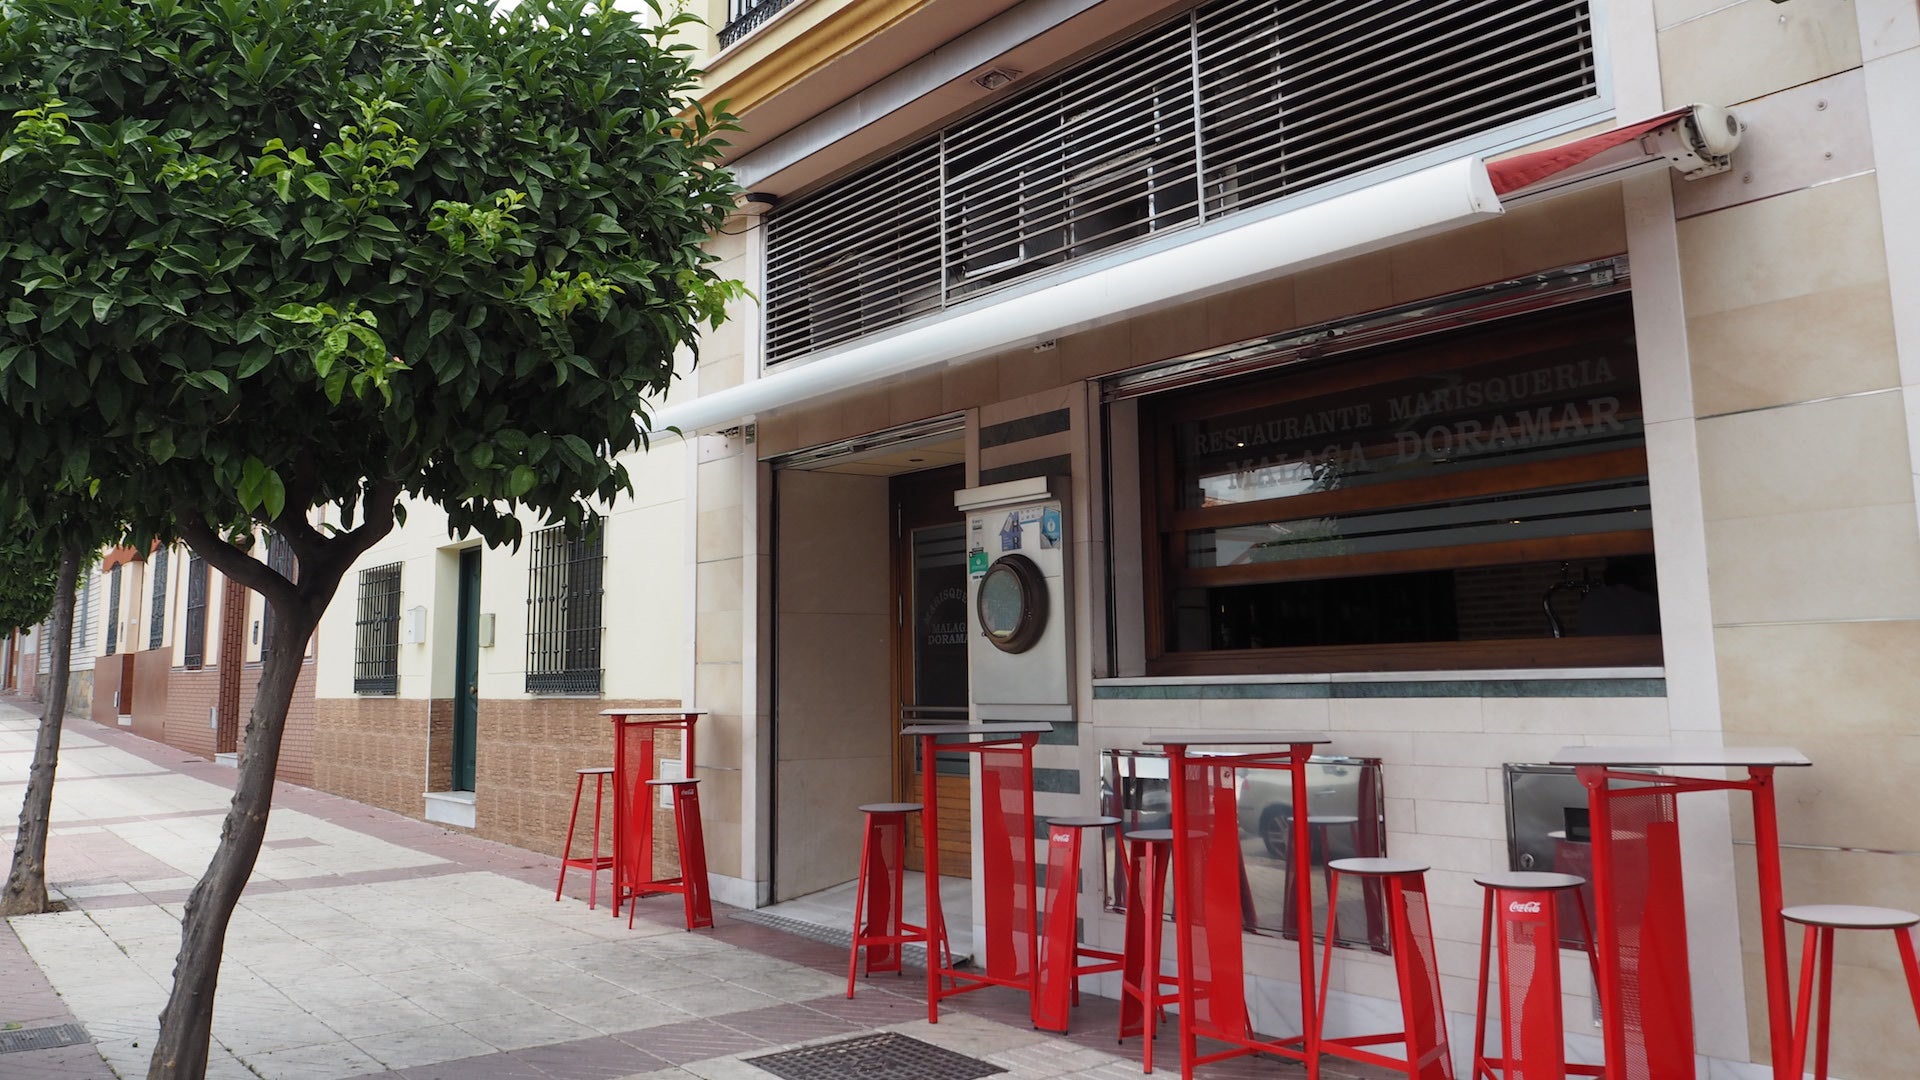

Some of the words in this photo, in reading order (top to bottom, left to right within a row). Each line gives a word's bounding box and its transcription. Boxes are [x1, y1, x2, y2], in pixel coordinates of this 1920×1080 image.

[1193, 404, 1372, 456] RESTAURANTE
[1387, 356, 1617, 422] MARISQUERIA
[1226, 441, 1369, 490] MALAGA
[1394, 396, 1625, 465] DORAMAR
[932, 623, 967, 633] MALAG
[1509, 901, 1541, 913] Coca-Cola
